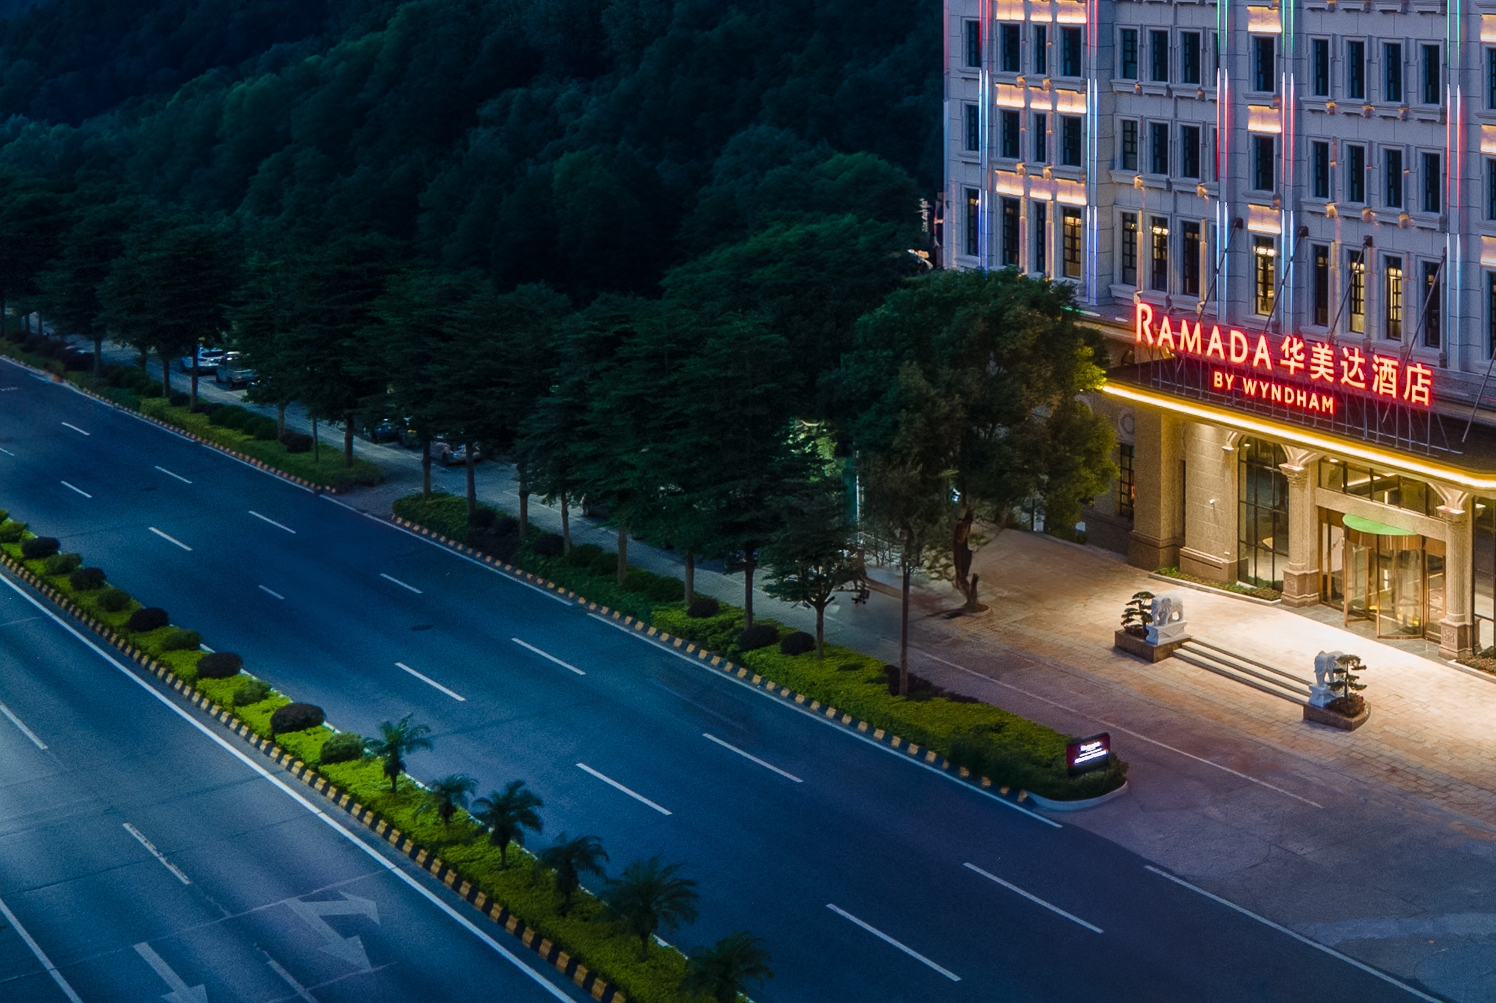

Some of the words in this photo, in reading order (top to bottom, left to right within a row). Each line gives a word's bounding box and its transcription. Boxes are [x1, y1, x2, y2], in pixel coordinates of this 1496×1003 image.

[1135, 301, 1274, 372] RAMADA
[1279, 334, 1433, 407] 华美达酒店
[1213, 370, 1235, 392] BY
[1242, 376, 1335, 415] WYNDHAM
